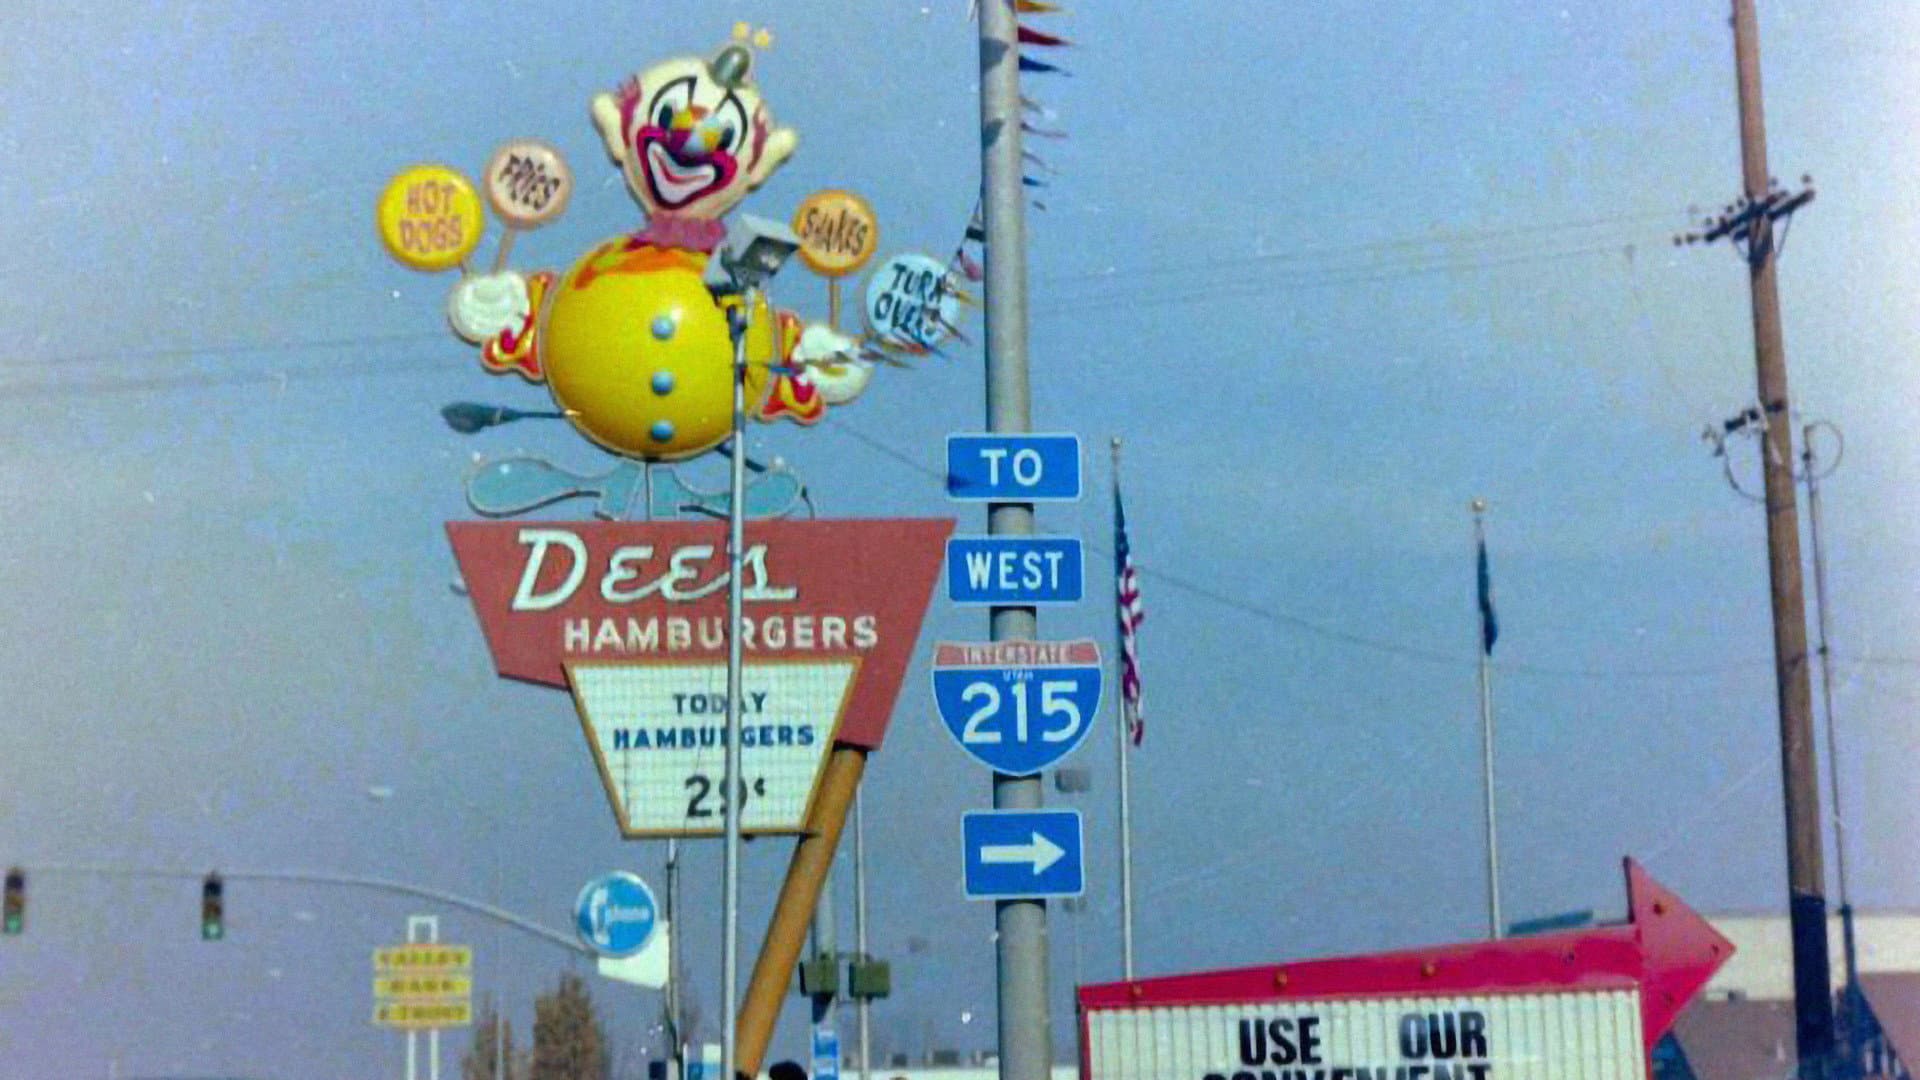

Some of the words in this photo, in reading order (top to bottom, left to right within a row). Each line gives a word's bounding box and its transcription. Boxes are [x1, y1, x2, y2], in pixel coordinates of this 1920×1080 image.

[406, 180, 457, 214] HOT
[399, 215, 463, 253] DOGS
[980, 447, 1043, 487] TO
[965, 551, 1064, 591] WEST
[964, 643, 1069, 665] INTERSTATE
[961, 681, 1081, 743] 215
[1238, 1016, 1322, 1066] USE
[1401, 1011, 1487, 1060] OUR
